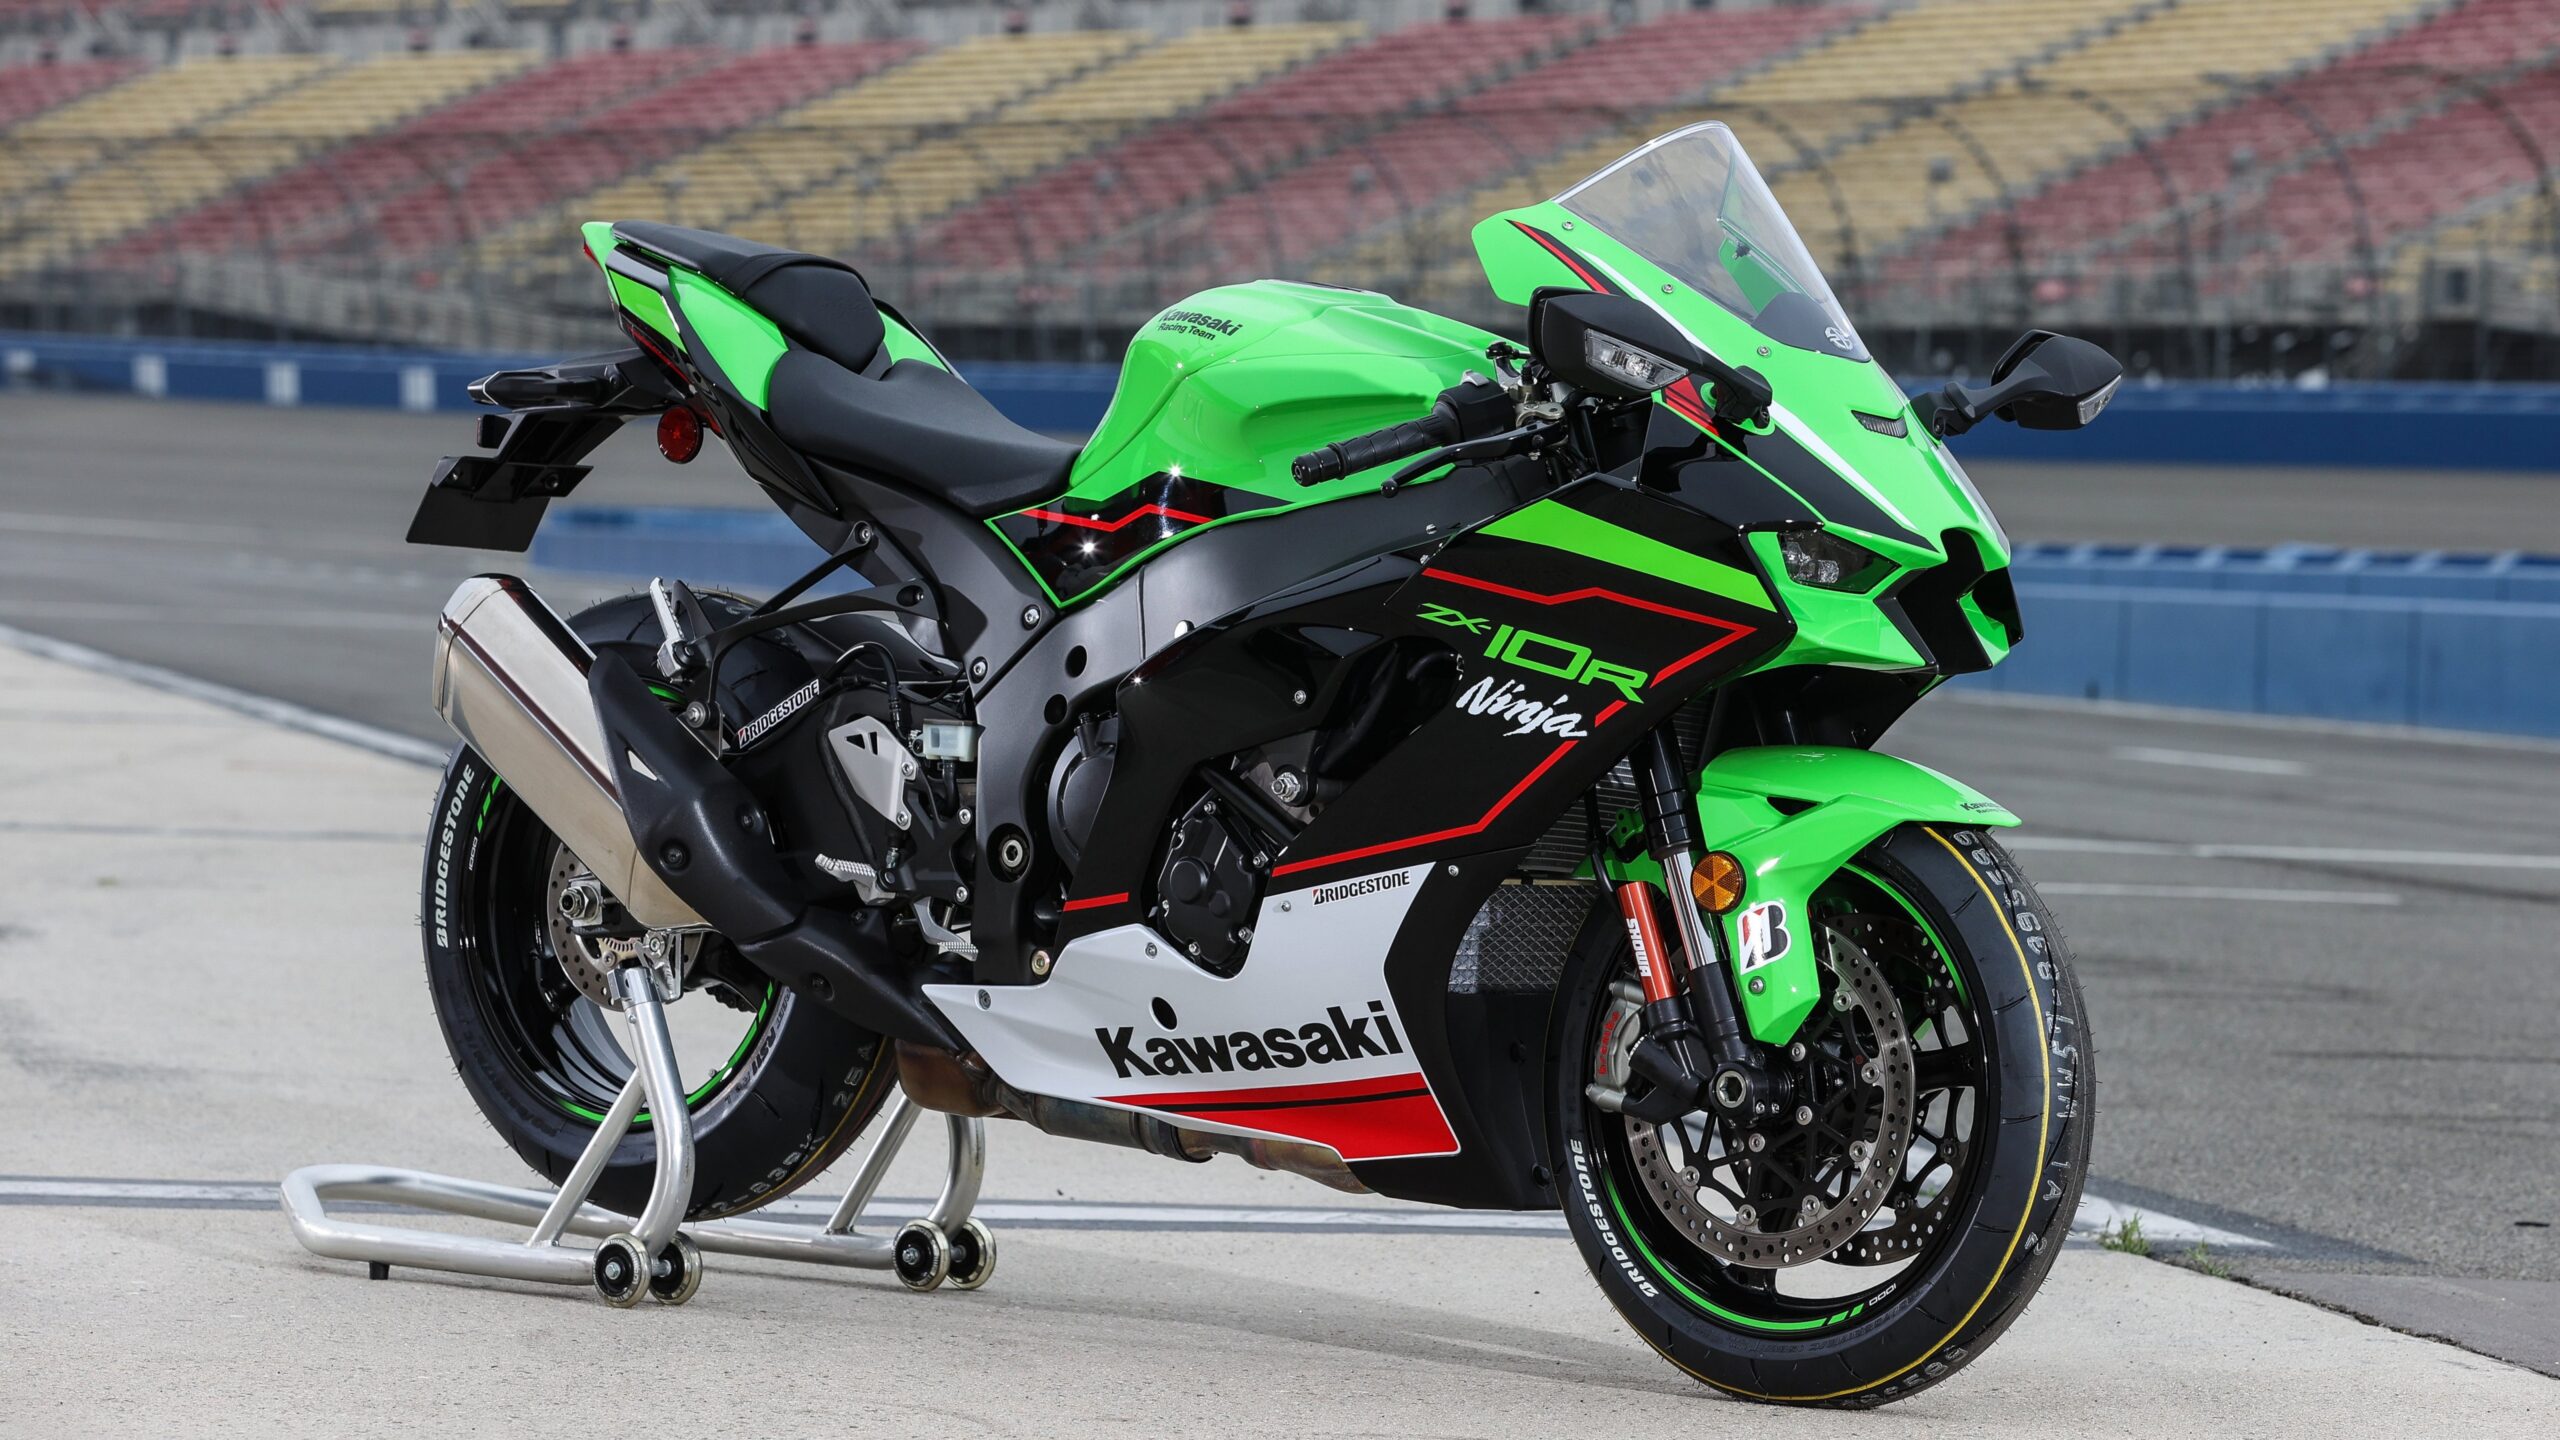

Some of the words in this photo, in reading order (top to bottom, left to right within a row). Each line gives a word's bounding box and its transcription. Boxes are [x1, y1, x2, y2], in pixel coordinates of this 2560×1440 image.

[1157, 323, 1188, 334] Racing
[1188, 326, 1216, 341] Team
[1159, 308, 1244, 337] Kawasaki
[1416, 603, 1649, 704] ZX-10R
[738, 680, 820, 749] BRIDGESTONE
[1456, 676, 1588, 738] Ninja
[435, 764, 475, 949] BRIDGESTONE
[468, 836, 478, 871] 1000
[1313, 871, 1411, 906] BRIDGESTONE
[1626, 917, 1652, 978] SHOWA
[1094, 999, 1404, 1079] Kawasaki
[1570, 1138, 1660, 1298] BRIDGESTONE
[1869, 1283, 1897, 1307] 1000
